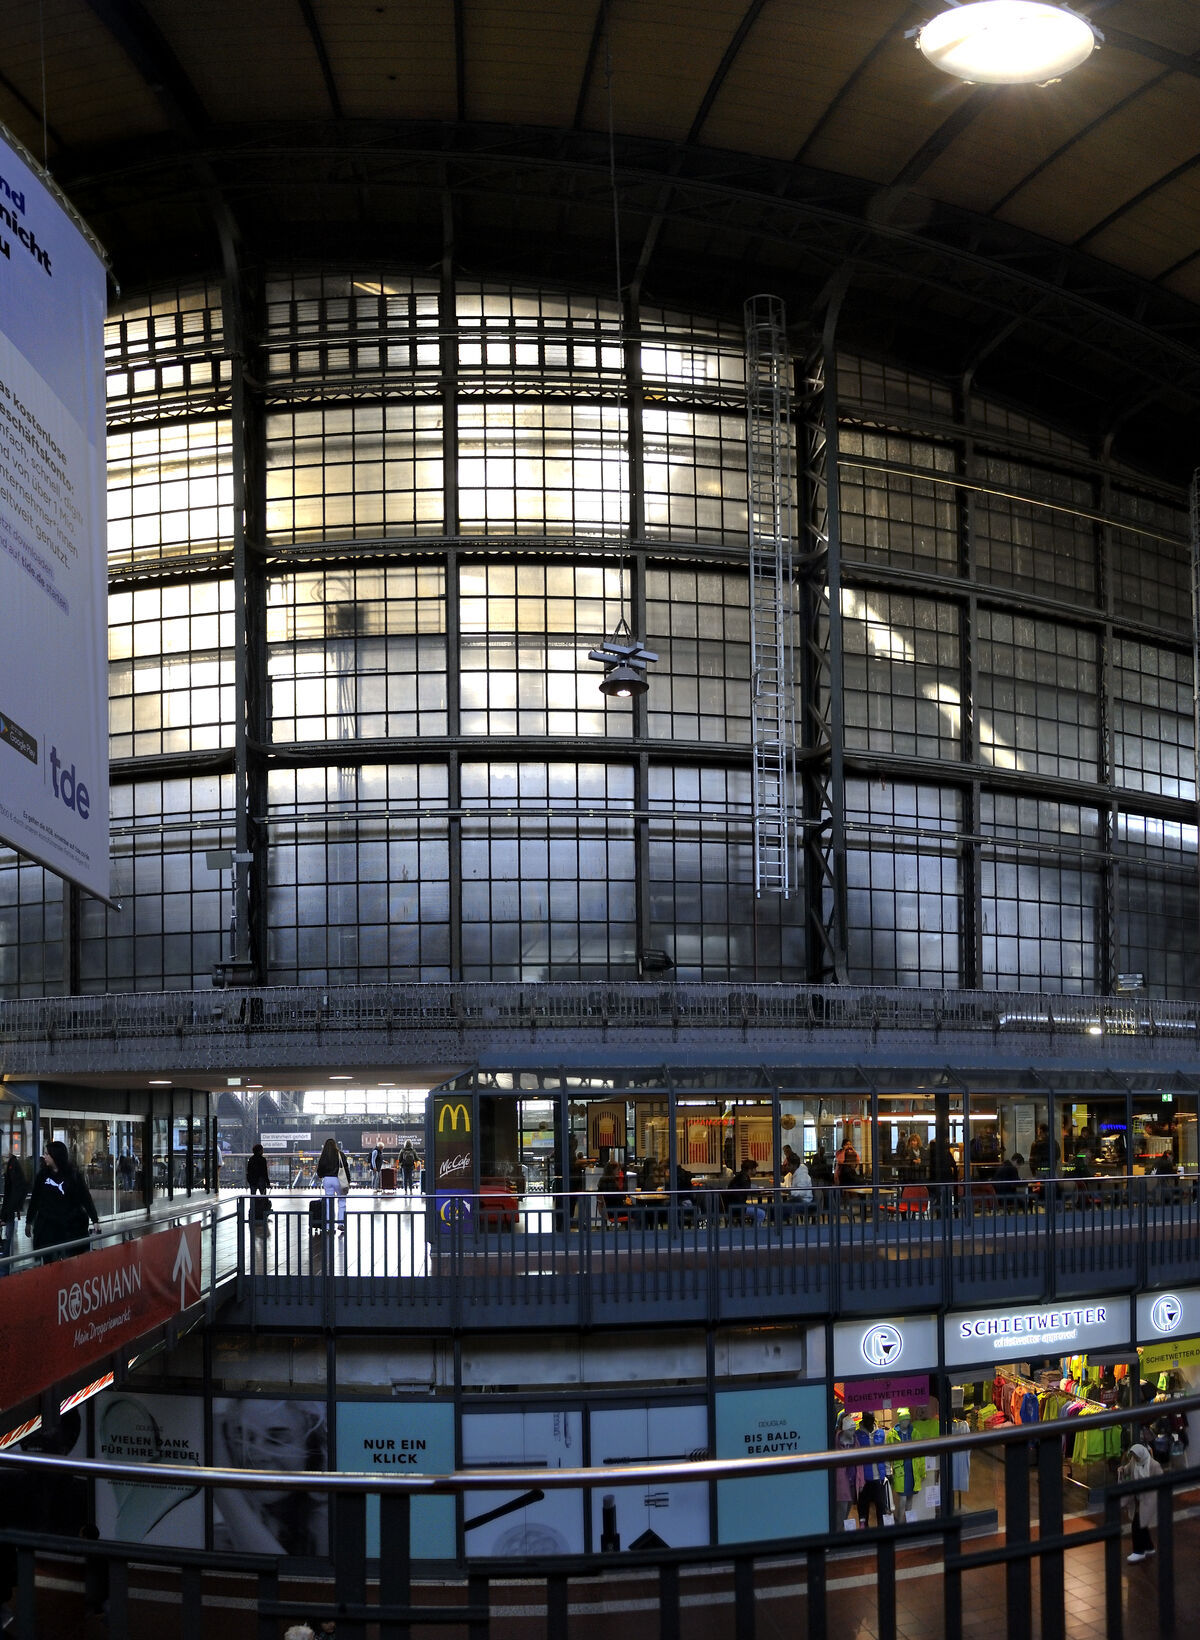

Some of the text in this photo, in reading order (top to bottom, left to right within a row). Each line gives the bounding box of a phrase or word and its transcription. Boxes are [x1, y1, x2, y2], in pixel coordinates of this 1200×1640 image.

[13, 392, 67, 465] kostenlose
[12, 456, 30, 483] von
[32, 475, 52, 508] über
[54, 501, 58, 514] 1
[60, 507, 76, 537] Mio.
[8, 545, 20, 561] auf
[35, 524, 71, 570] genutzt.
[9, 730, 26, 751] Google
[57, 1260, 142, 1326] ROSSMANN
[73, 1305, 131, 1348] Mein Drogeriemarkt
[961, 1308, 1106, 1337] SCHIETWETTER
[110, 1434, 190, 1449] VIELEN DANK
[363, 1439, 427, 1450] NUR EIN
[744, 1431, 801, 1443] BIS BALD,
[101, 1444, 200, 1461] FÜR IHRE TREUE!
[748, 1442, 798, 1455] BEAUTY!
[372, 1453, 419, 1464] KLICK
